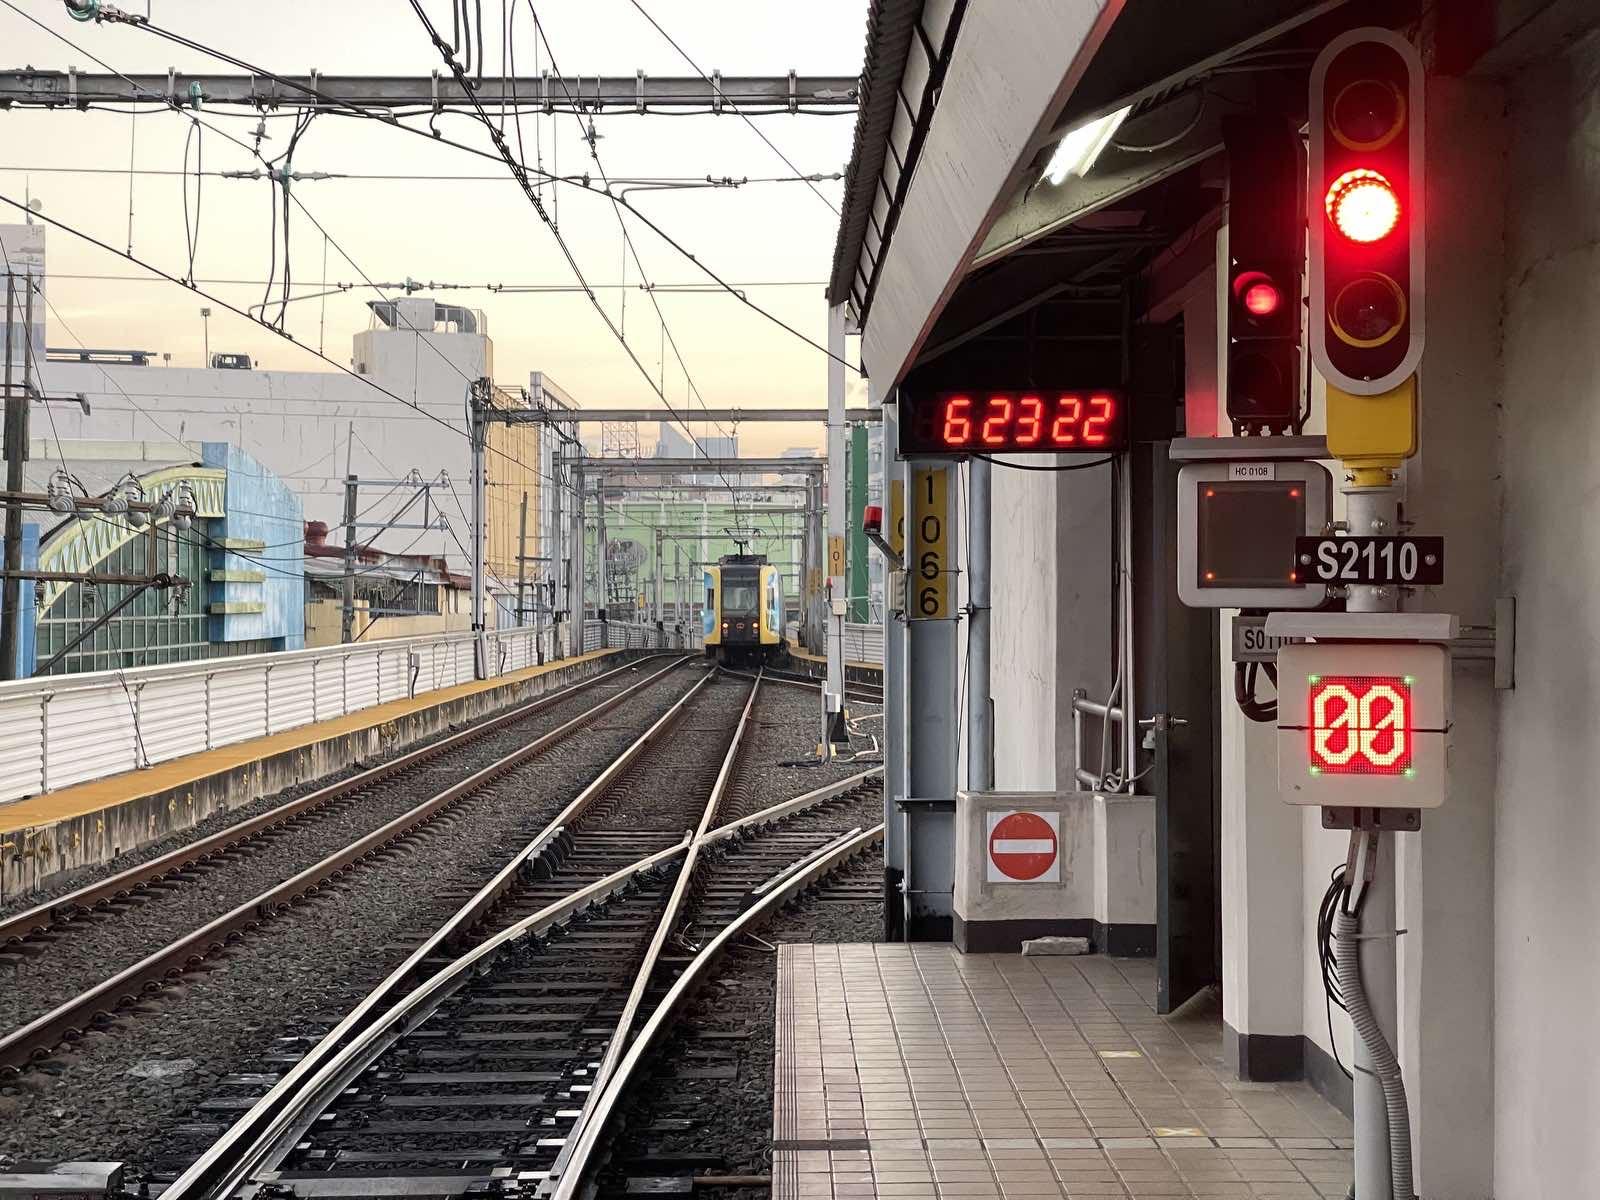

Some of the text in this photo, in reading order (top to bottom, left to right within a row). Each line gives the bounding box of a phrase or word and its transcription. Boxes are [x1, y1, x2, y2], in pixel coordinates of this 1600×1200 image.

[1235, 467, 1247, 476] HC
[919, 474, 941, 616] 1066
[1317, 540, 1418, 580] S2110
[1314, 685, 1404, 766] 00
